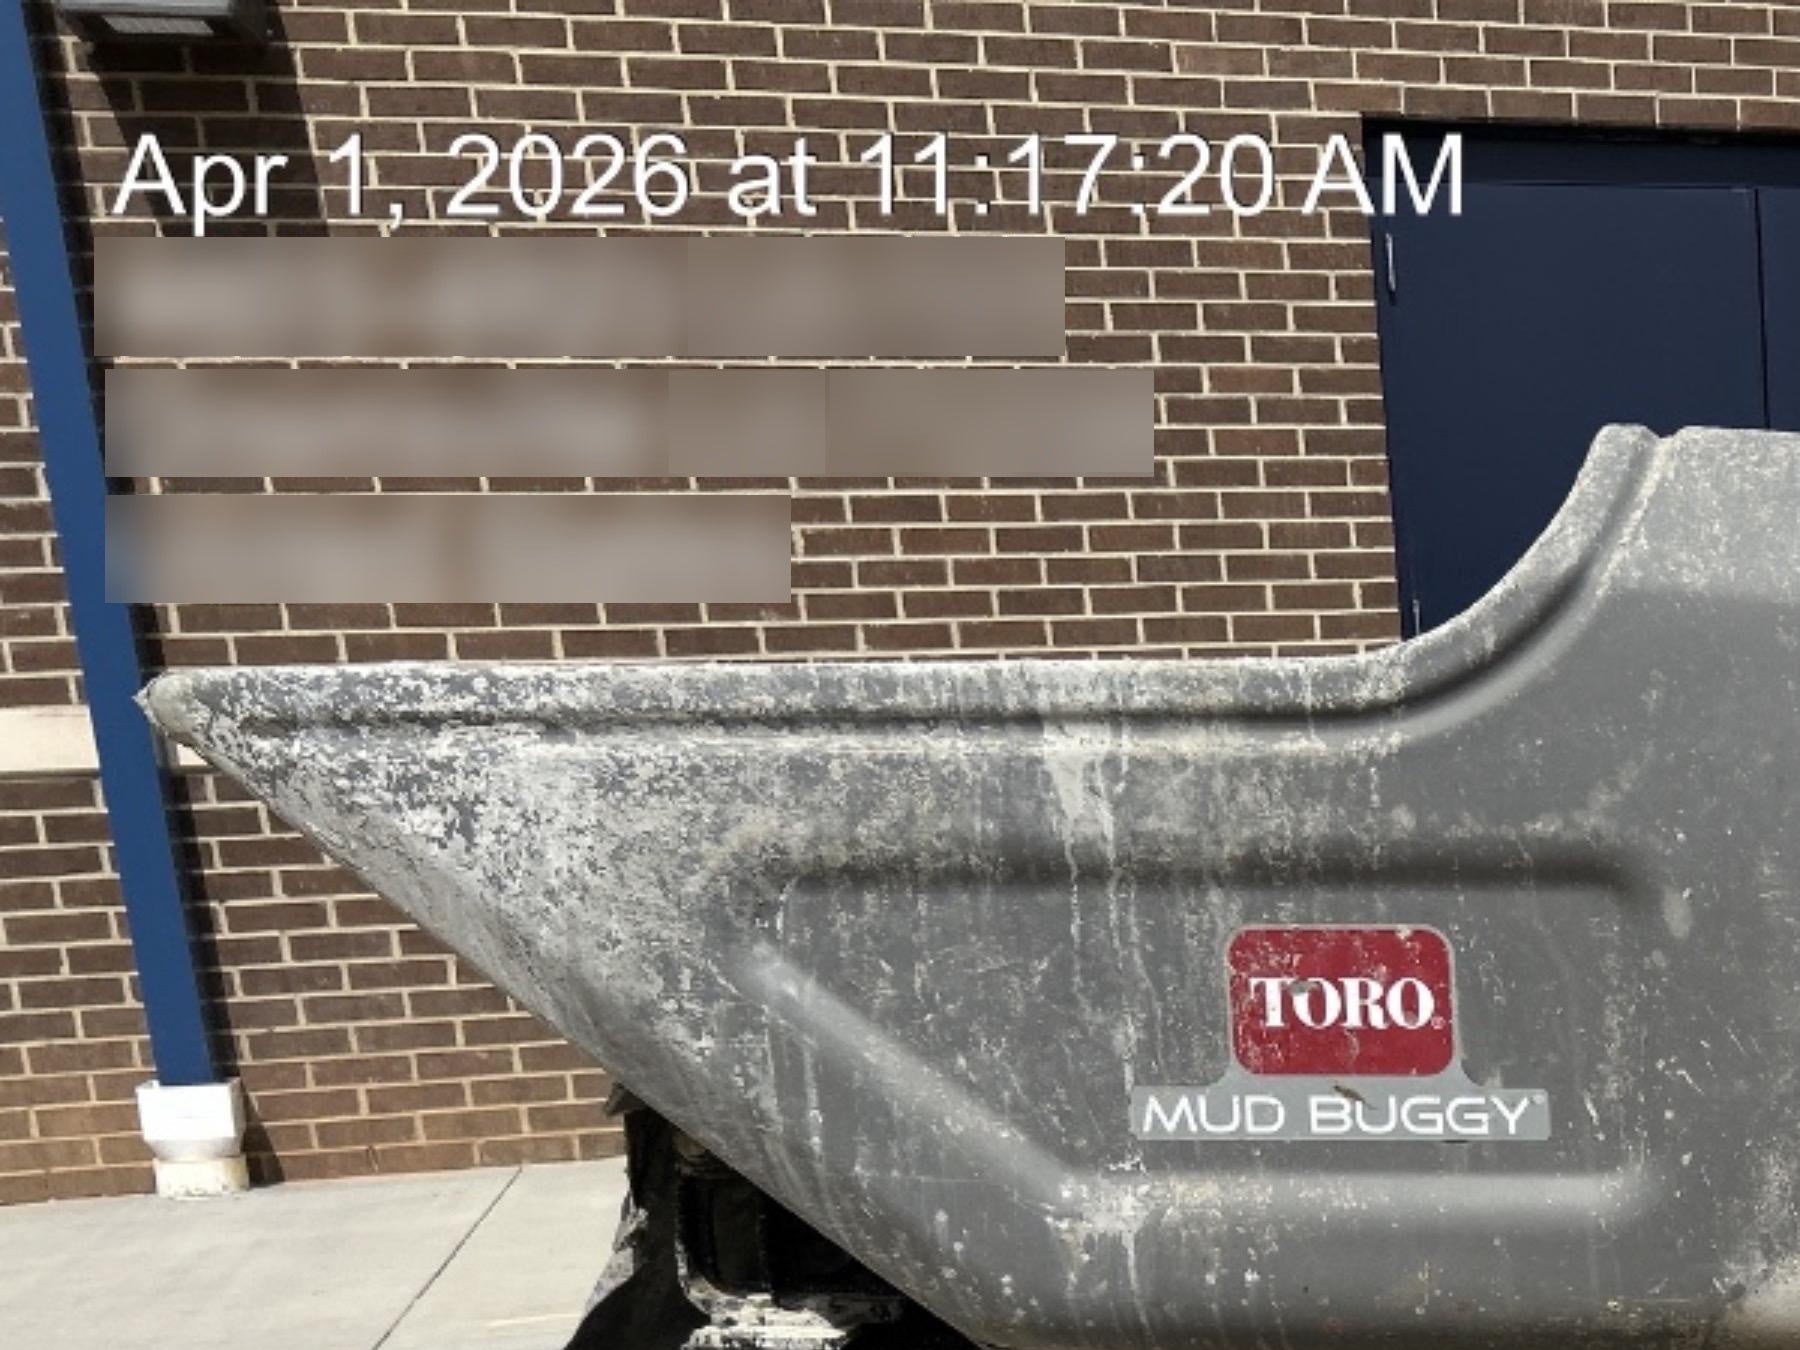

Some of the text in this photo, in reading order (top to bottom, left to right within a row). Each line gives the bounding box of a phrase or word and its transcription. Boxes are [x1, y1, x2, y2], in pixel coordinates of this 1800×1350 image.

[1249, 977, 1434, 1030] TORO
[1143, 1095, 1531, 1135] MUD BUGGY
